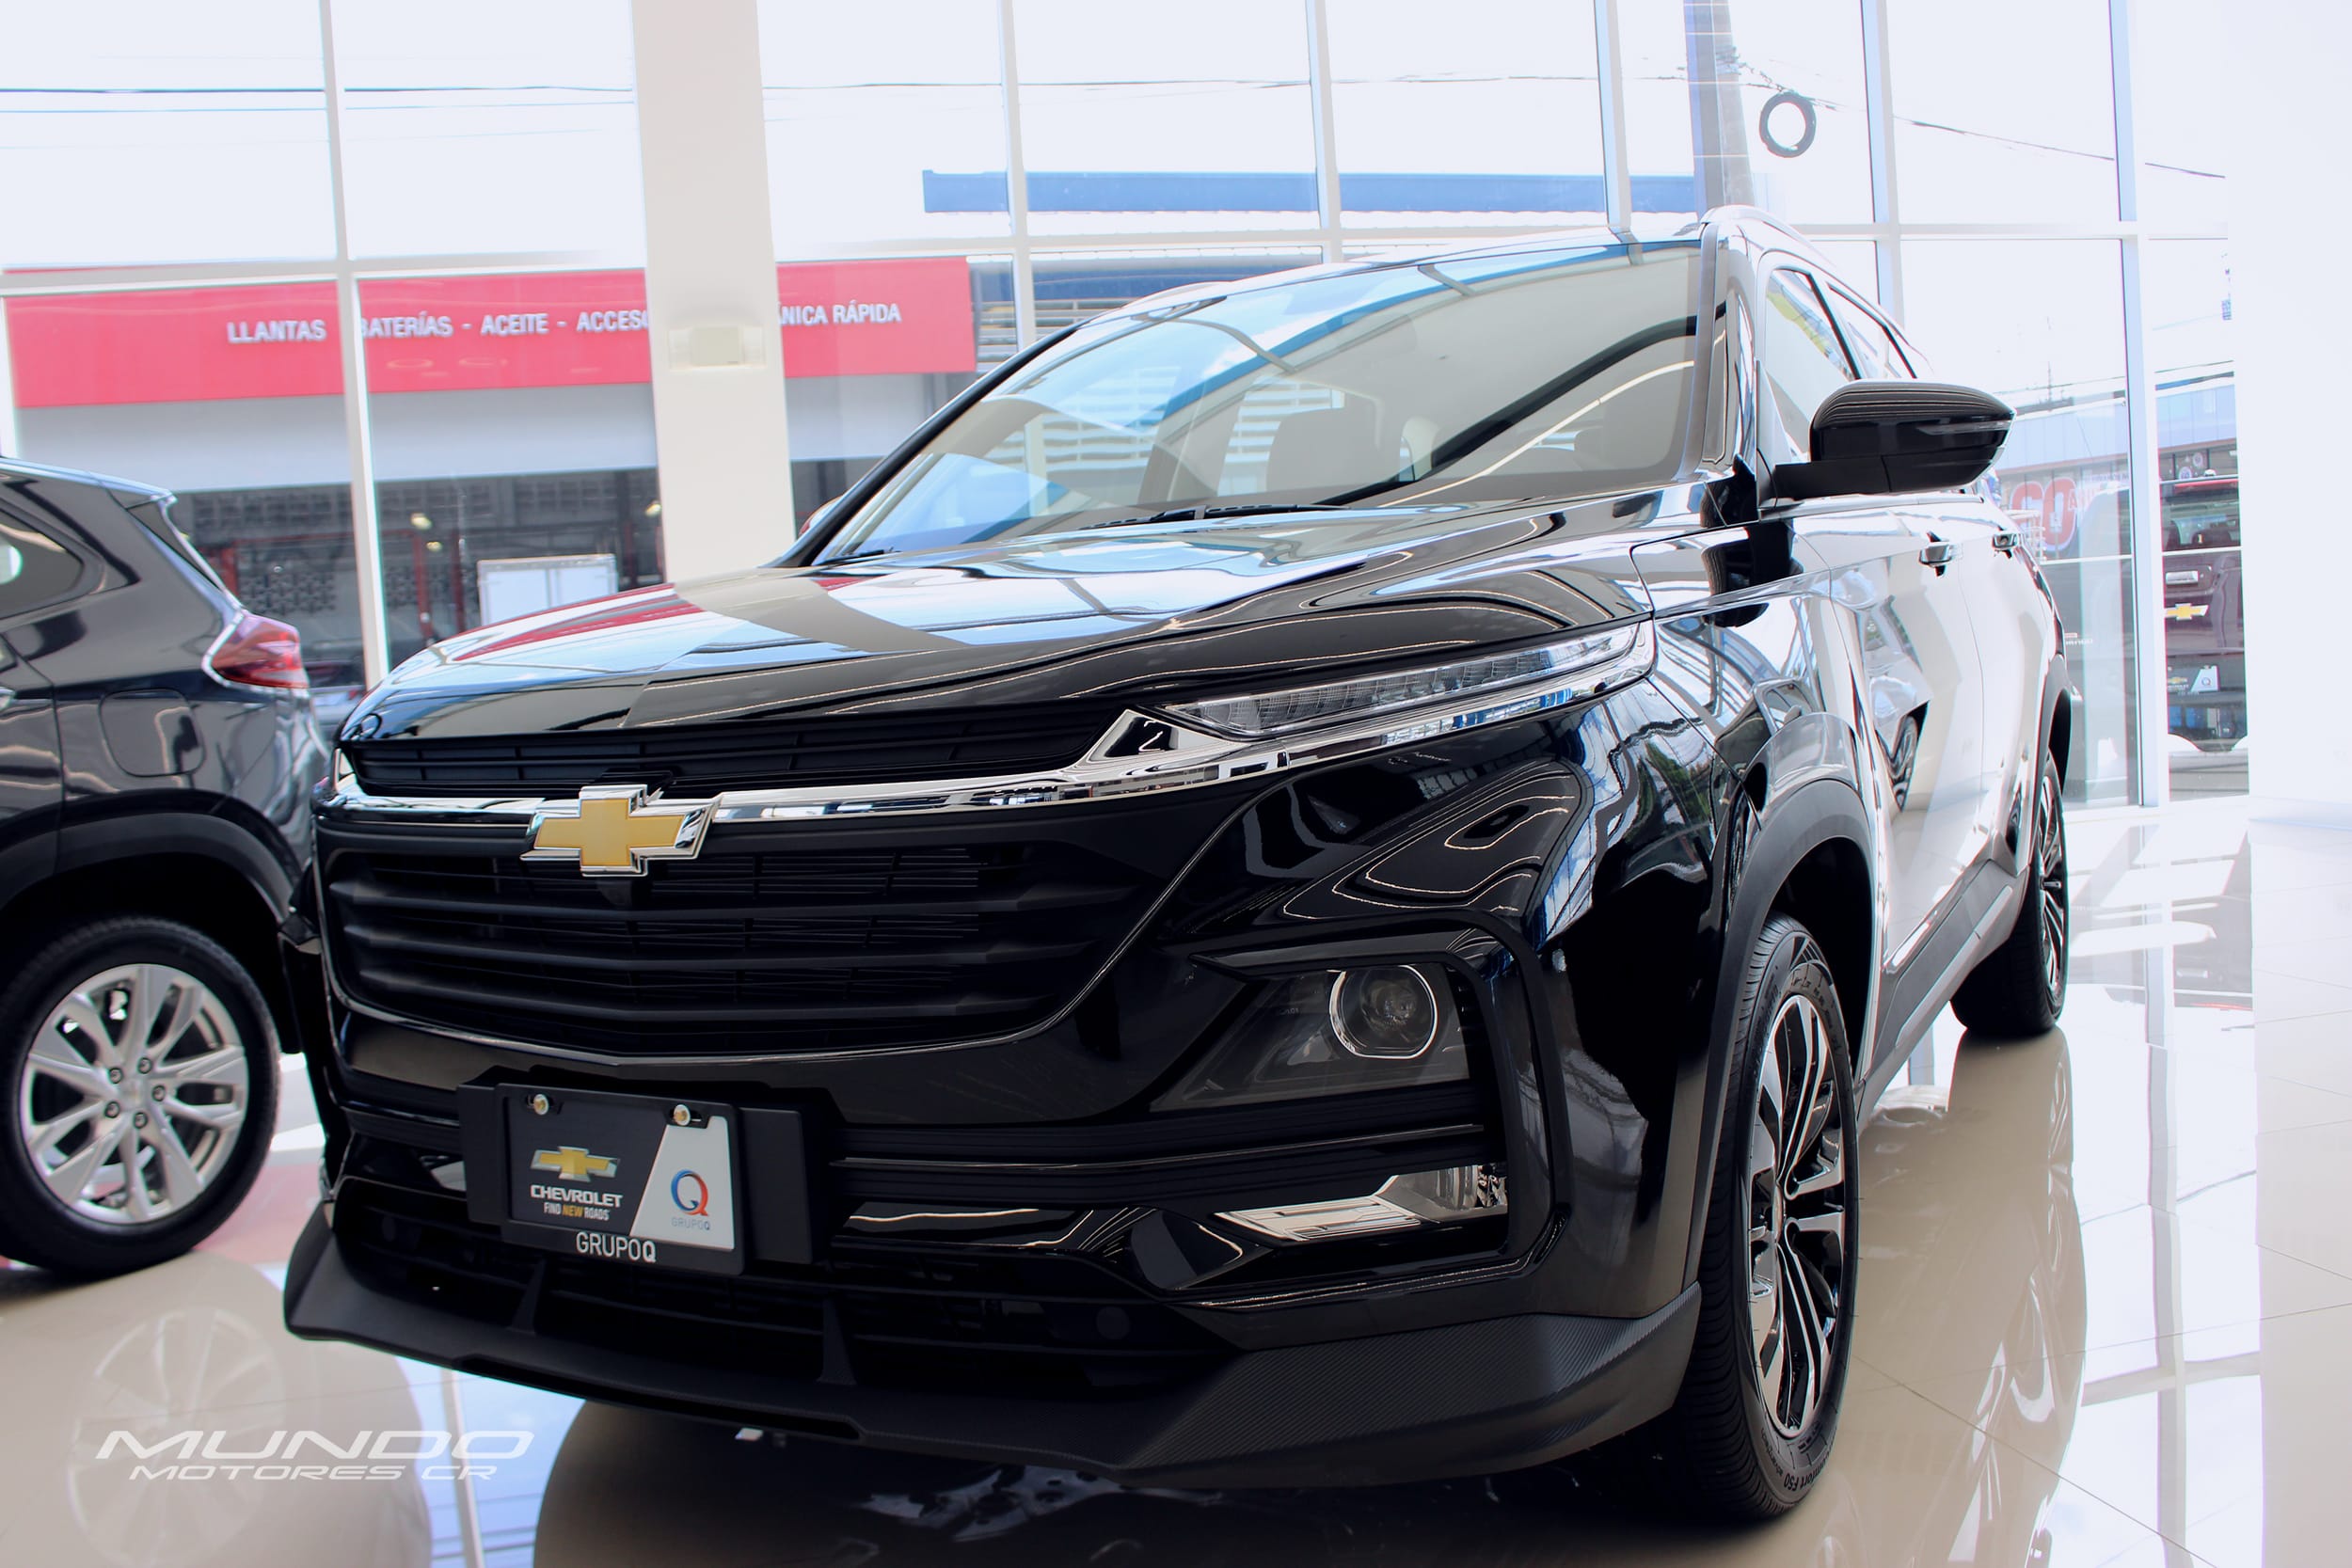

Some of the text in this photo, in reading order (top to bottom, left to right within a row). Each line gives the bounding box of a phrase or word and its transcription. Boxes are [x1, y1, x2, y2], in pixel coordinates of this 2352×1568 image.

[227, 319, 327, 343] LLANTAS
[481, 313, 548, 336] ACEITE
[833, 300, 902, 325] RÁPIDA
[530, 1184, 624, 1209] CHEVROLET
[671, 1169, 710, 1217] Q
[544, 1202, 610, 1221] FIND NEW ROADS
